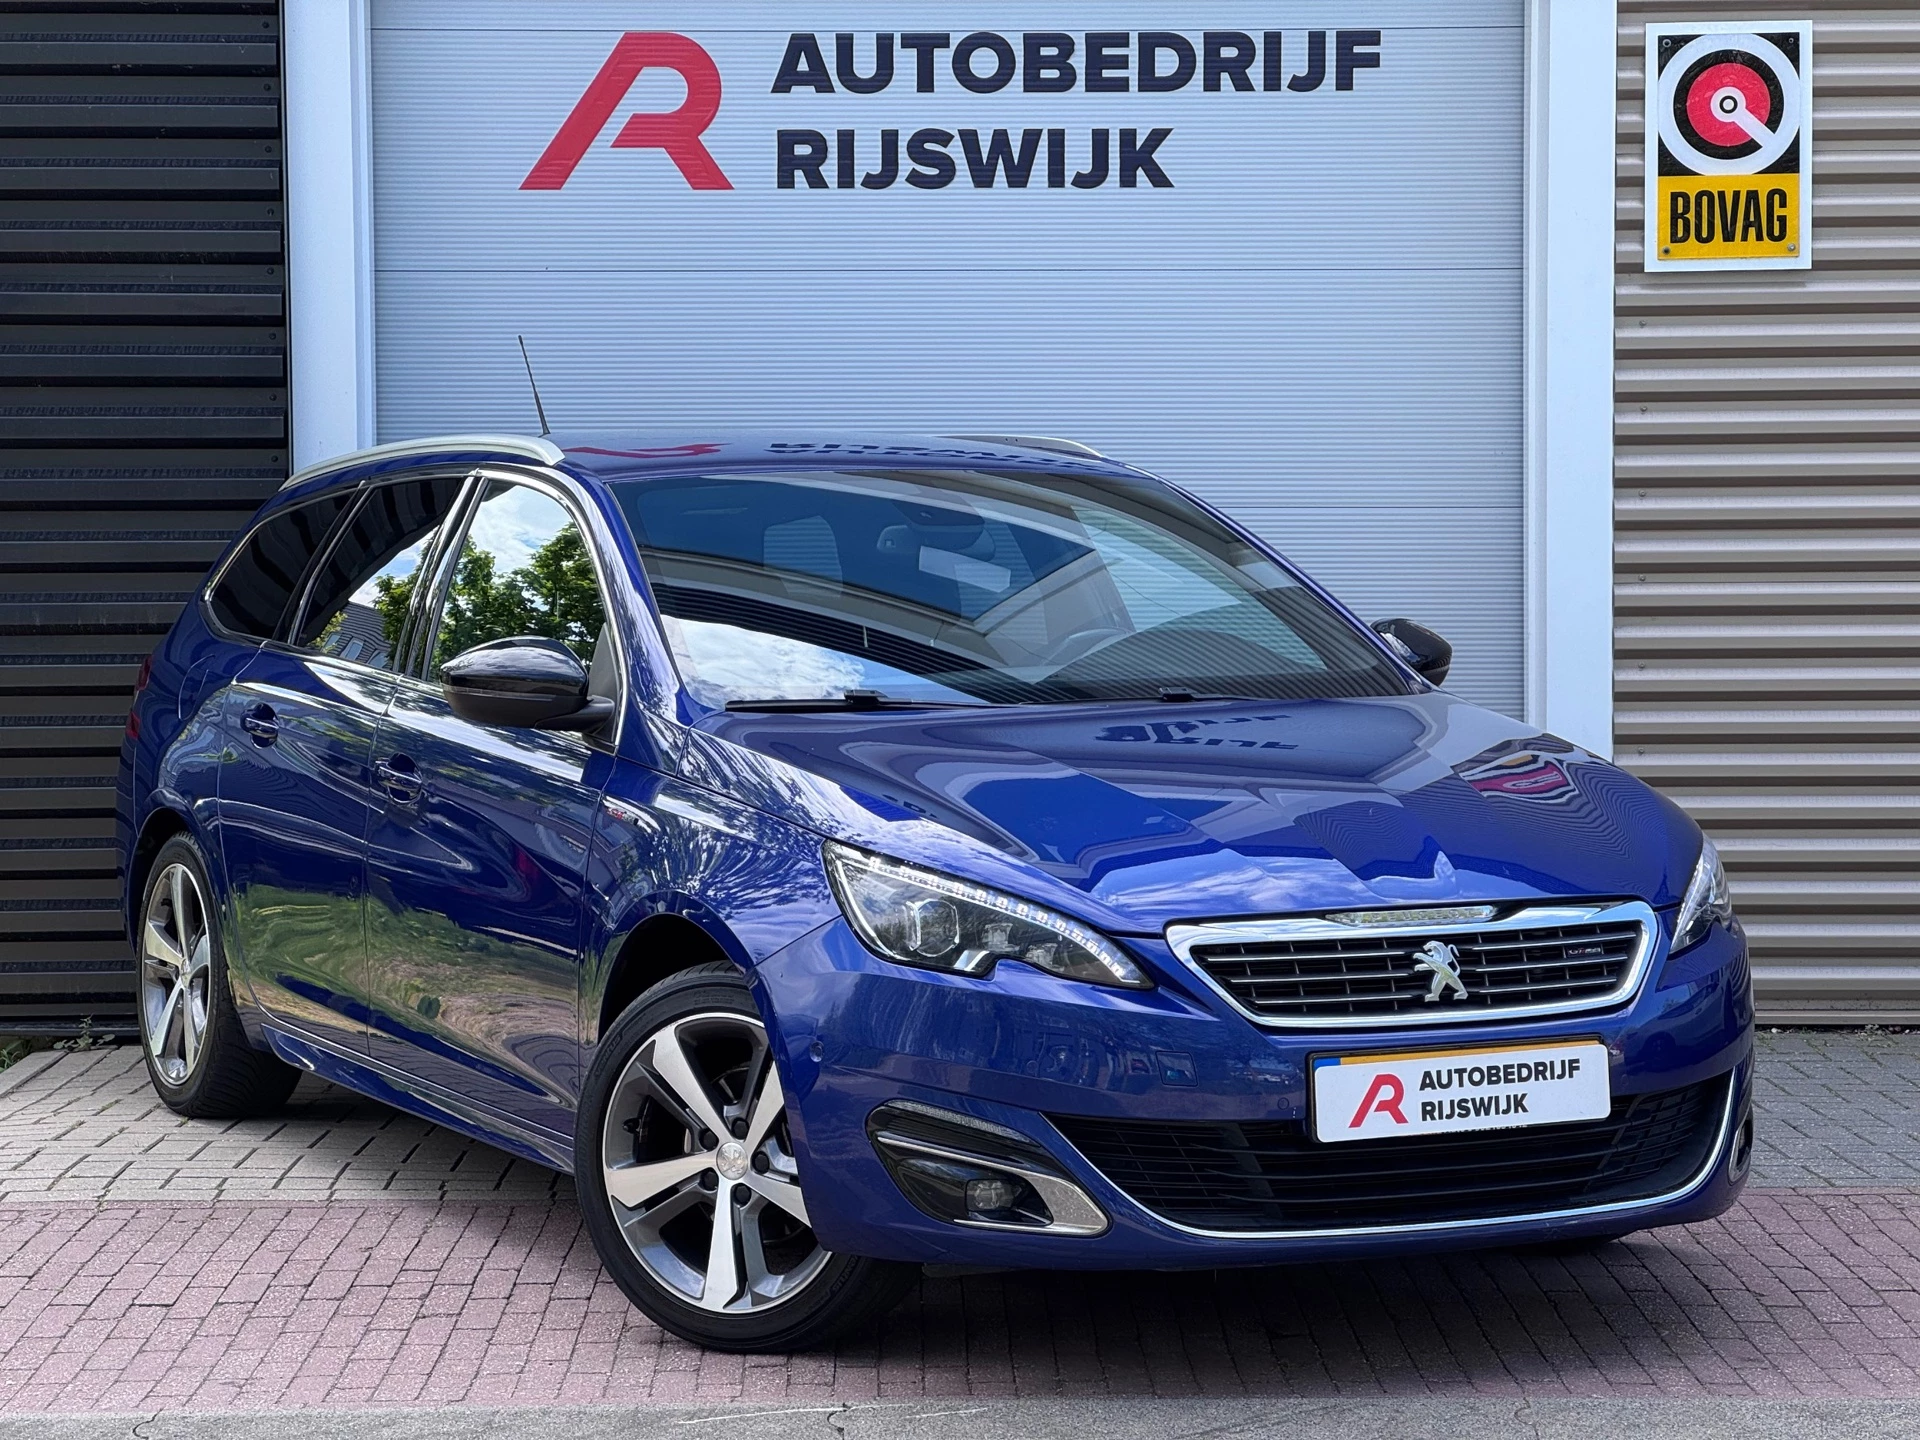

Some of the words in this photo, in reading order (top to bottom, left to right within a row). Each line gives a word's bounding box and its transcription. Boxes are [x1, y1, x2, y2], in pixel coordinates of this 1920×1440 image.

[771, 30, 1382, 94] AUTOBEDRIJF
[777, 128, 1175, 190] RIJSWIJK
[1669, 188, 1788, 244] BOVAG
[1419, 1058, 1581, 1091] AUTOBEDRIJF
[1420, 1093, 1529, 1121] RIJSWIJK
